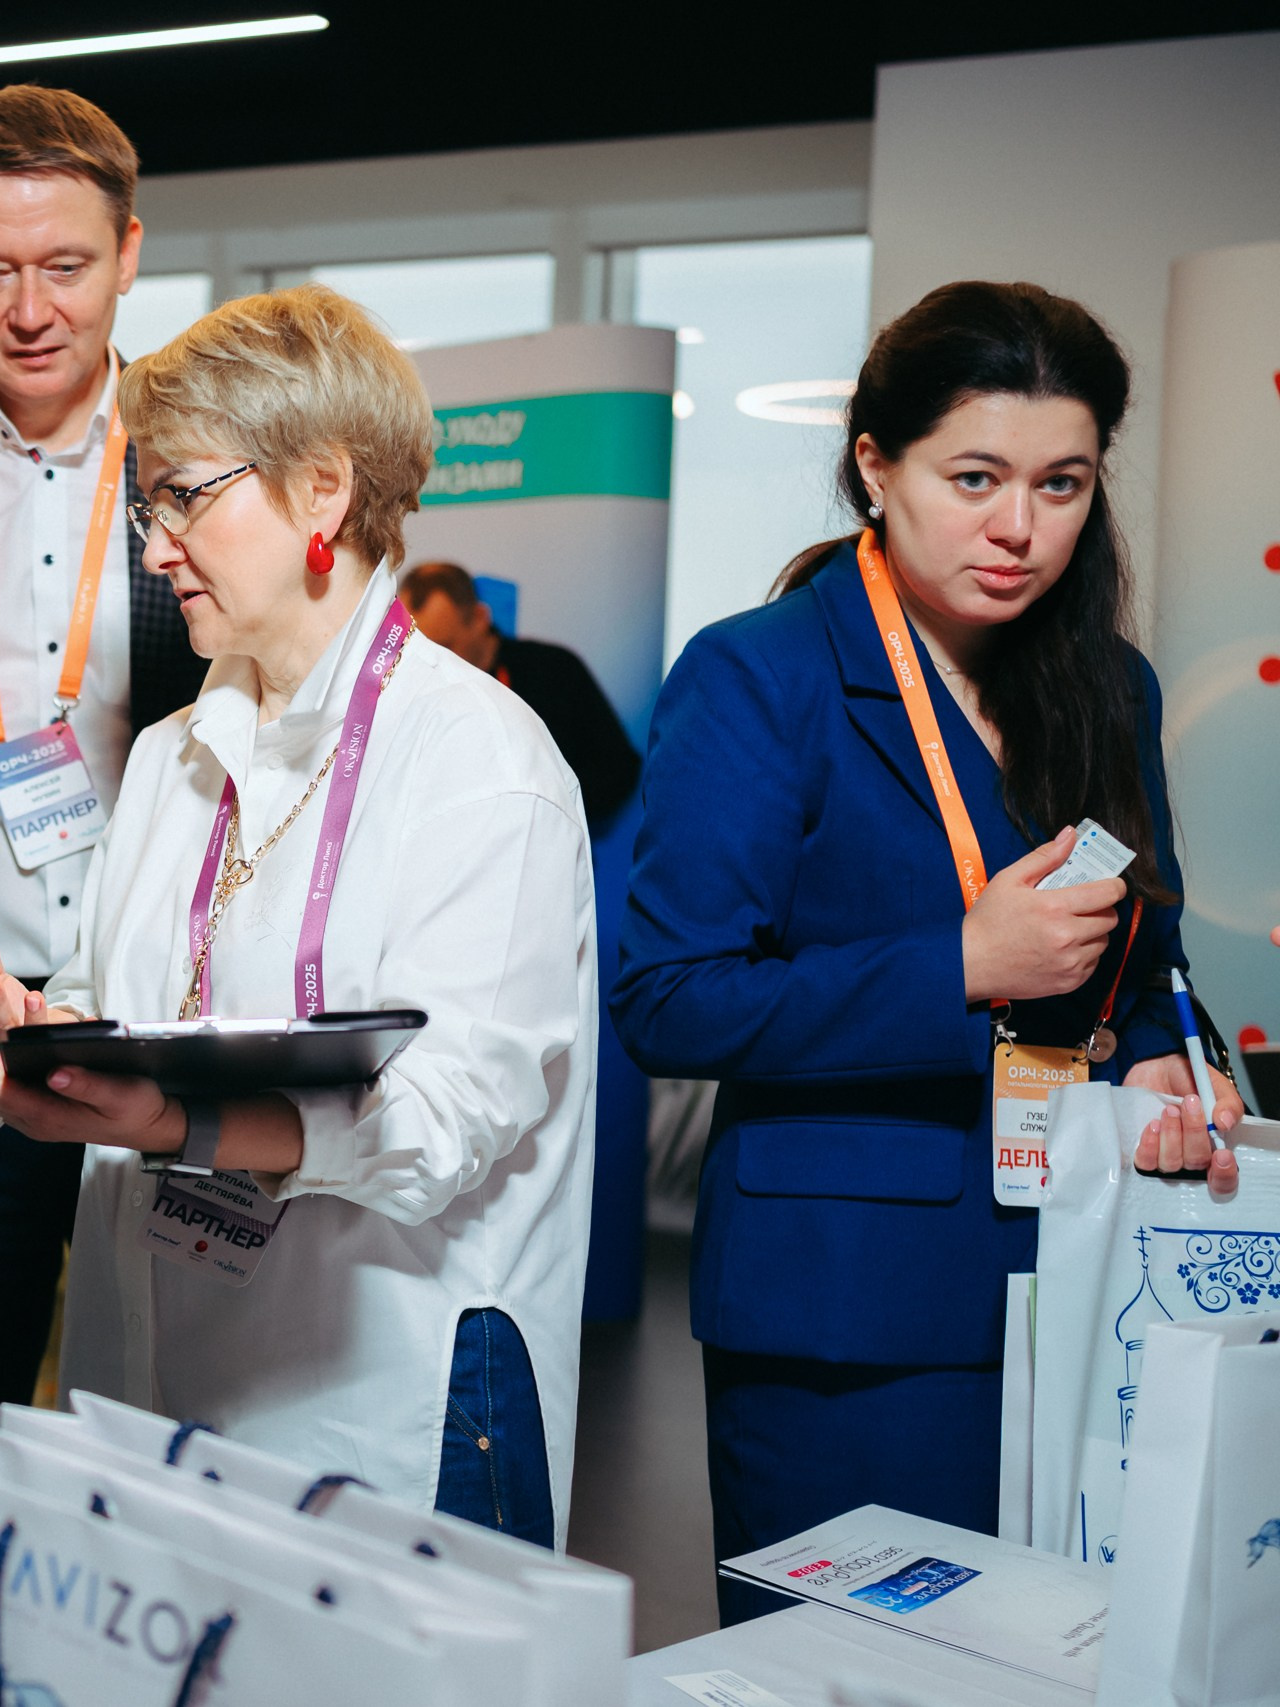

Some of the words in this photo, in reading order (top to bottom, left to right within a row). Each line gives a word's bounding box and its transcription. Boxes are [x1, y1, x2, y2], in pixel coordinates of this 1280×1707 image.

[372, 623, 403, 675] ОРЧ-2025
[887, 631, 915, 689] ОРЧ-2025
[343, 723, 366, 778] OKVISION
[11, 798, 98, 842] ПАРТНЕР
[963, 859, 978, 905] OKVISI
[1008, 1065, 1075, 1082] ОРЧ-2025
[212, 1169, 258, 1194] ВЕТЛАНА
[997, 1148, 1049, 1169] ДЕЛЕ
[194, 1181, 253, 1209] ДЕГТЯРЁВА
[151, 1194, 266, 1250] ПАРТНЕР
[10, 1548, 194, 1667] AVIZO
